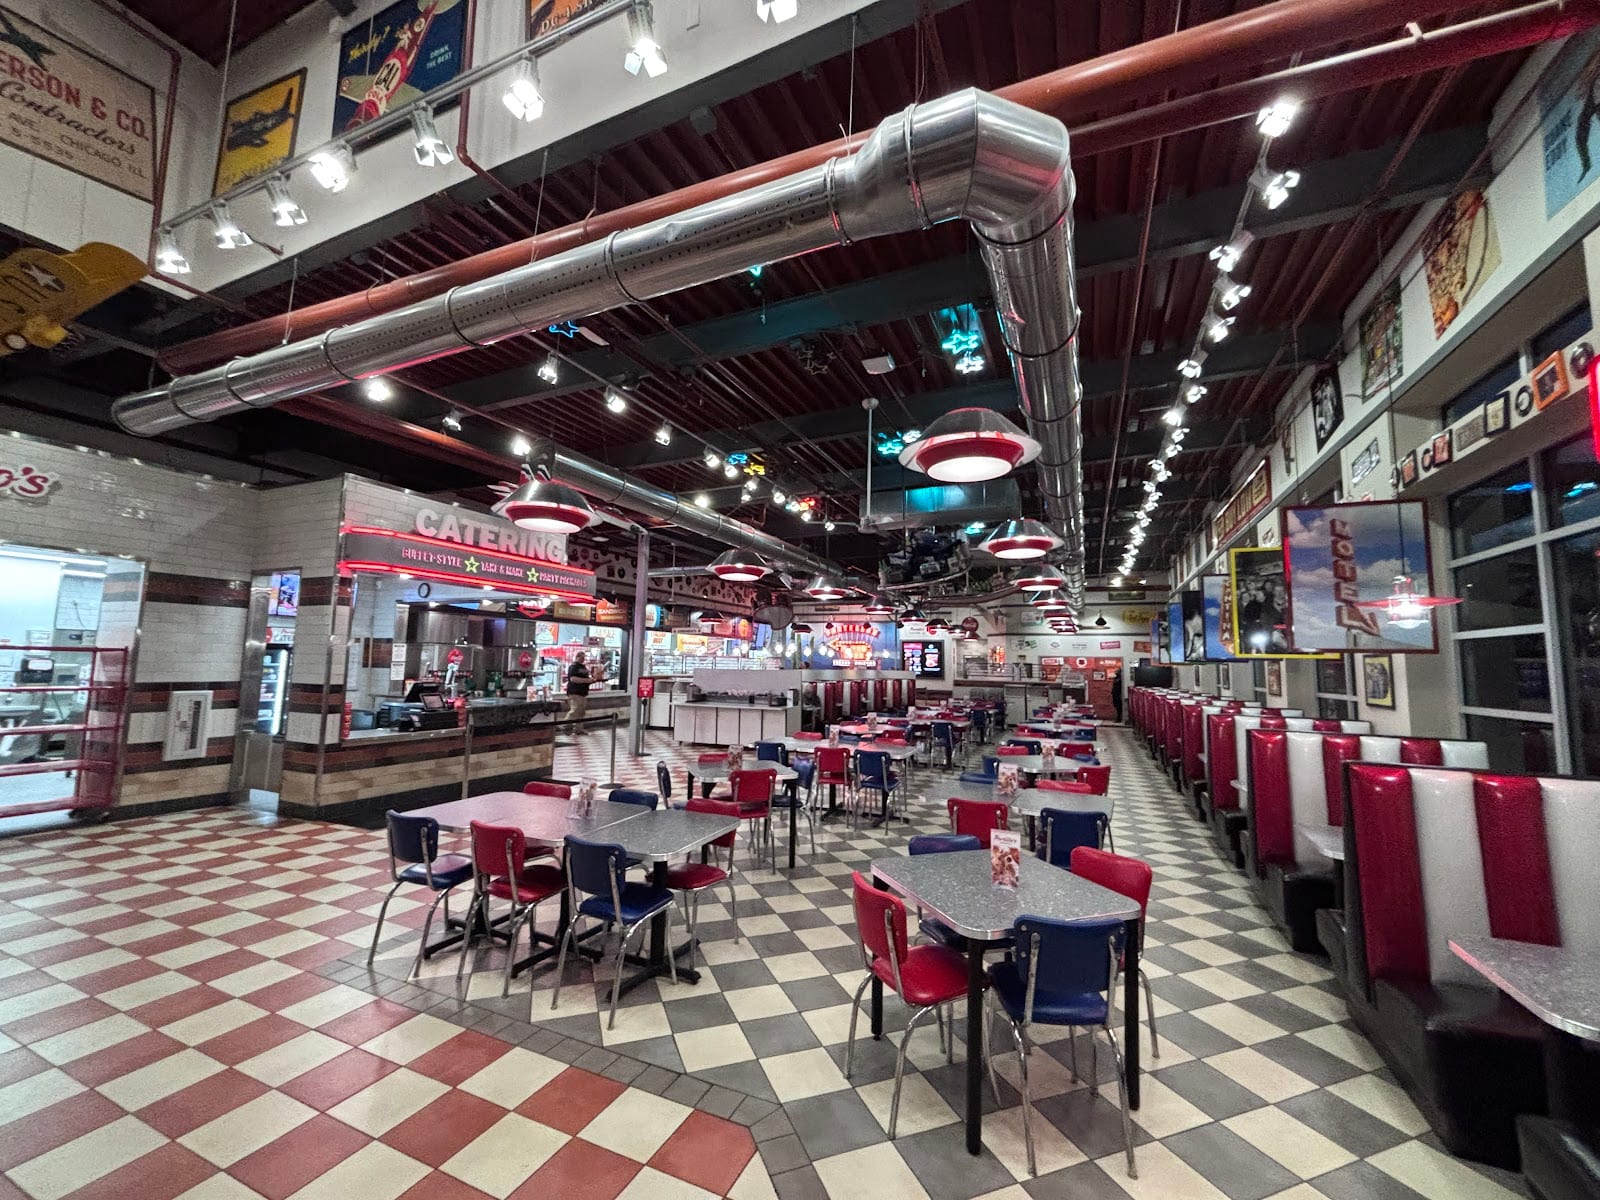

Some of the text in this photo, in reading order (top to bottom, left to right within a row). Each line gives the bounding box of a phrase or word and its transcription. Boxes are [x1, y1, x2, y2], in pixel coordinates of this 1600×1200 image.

[426, 51, 453, 69] THE BEST
[430, 44, 449, 59] DRINK
[0, 80, 136, 156] Contractors
[91, 96, 107, 121] &
[59, 134, 122, 168] CHICAGO
[415, 508, 566, 565] CATERING
[401, 547, 463, 568] BUFFET-STYLE
[539, 572, 559, 584] PARTY
